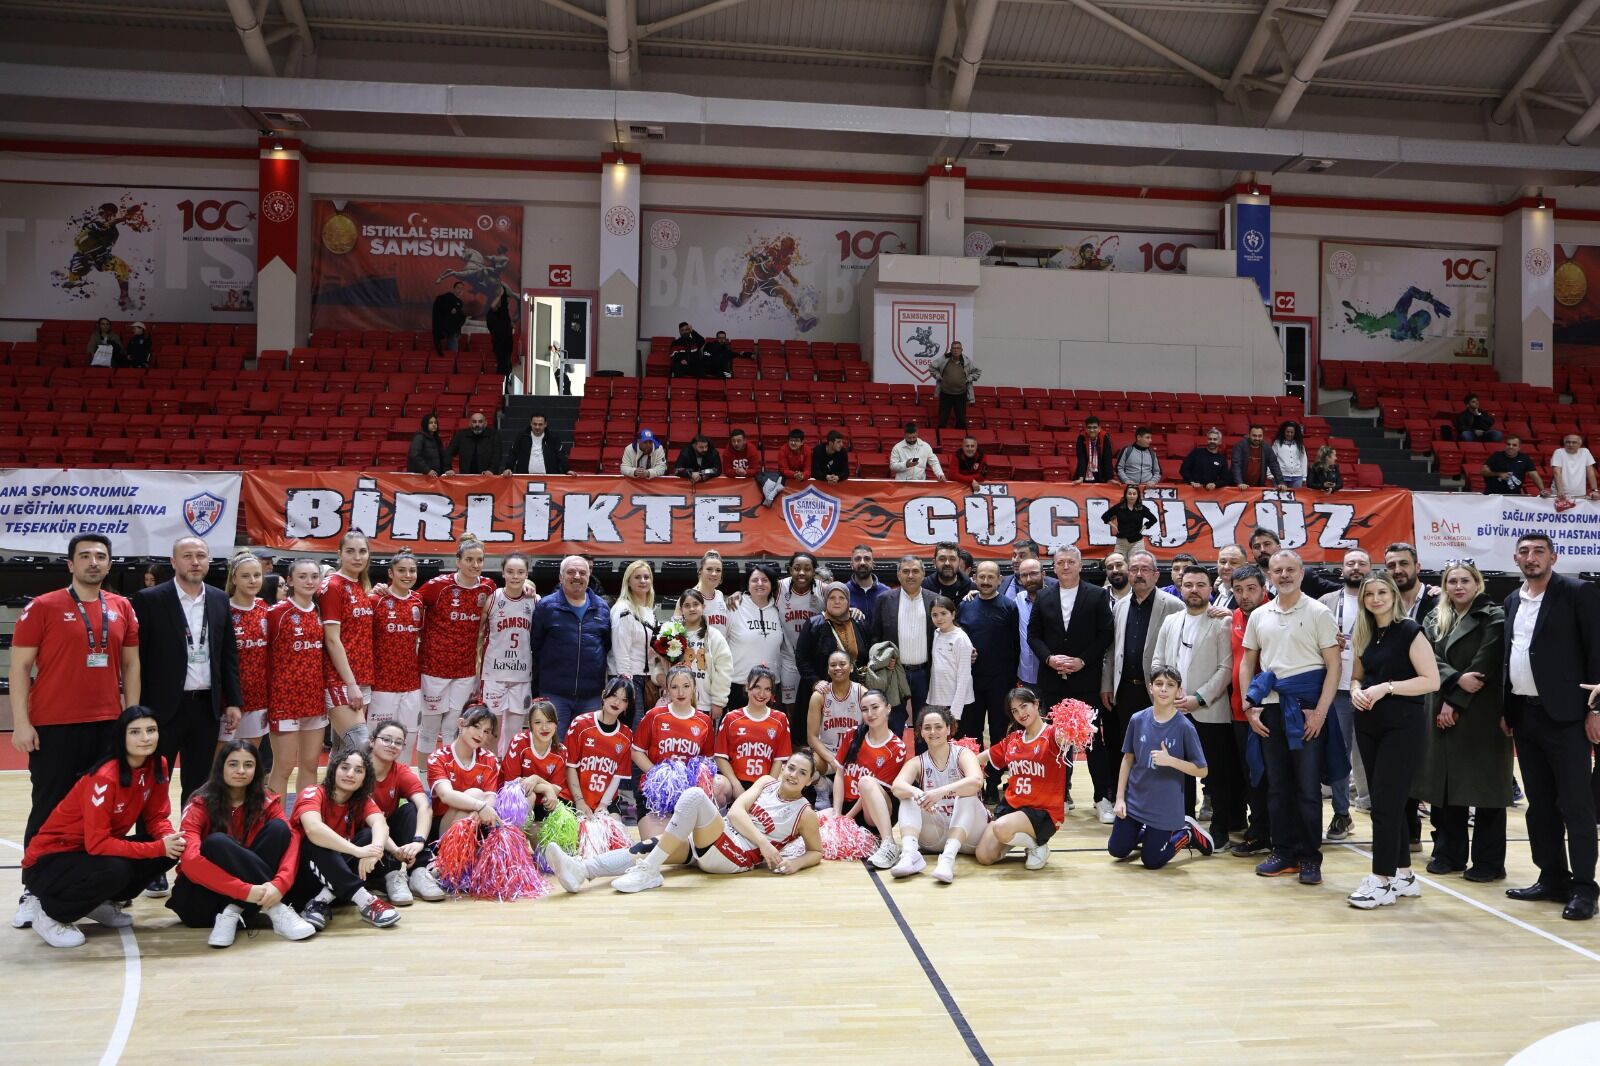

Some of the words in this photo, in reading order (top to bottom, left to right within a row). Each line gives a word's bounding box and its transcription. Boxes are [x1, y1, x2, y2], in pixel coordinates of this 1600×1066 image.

[370, 238, 465, 257] SAMSUN
[549, 268, 571, 283] C3
[1276, 295, 1295, 309] C2
[902, 312, 946, 321] SAMSUNSPOR
[0, 485, 27, 497] ANA
[31, 485, 139, 497] SPONSORUMUZ
[14, 500, 65, 515] EĞİTİM
[66, 504, 166, 516] KURUMLARINA
[284, 478, 742, 543] BİRLİKTE
[797, 500, 826, 510] SAMSUN
[1502, 509, 1535, 522] SAĞLIK
[1536, 513, 1600, 524] SPONSORUM
[5, 519, 77, 536] TEŞEKKÜR
[79, 520, 129, 534] EDERİZ
[1477, 524, 1509, 537] BÜYÜK
[510, 633, 519, 649] 5
[745, 758, 763, 776] 55
[588, 773, 607, 793] 55
[850, 780, 860, 796] 5
[1015, 777, 1032, 795] 55
